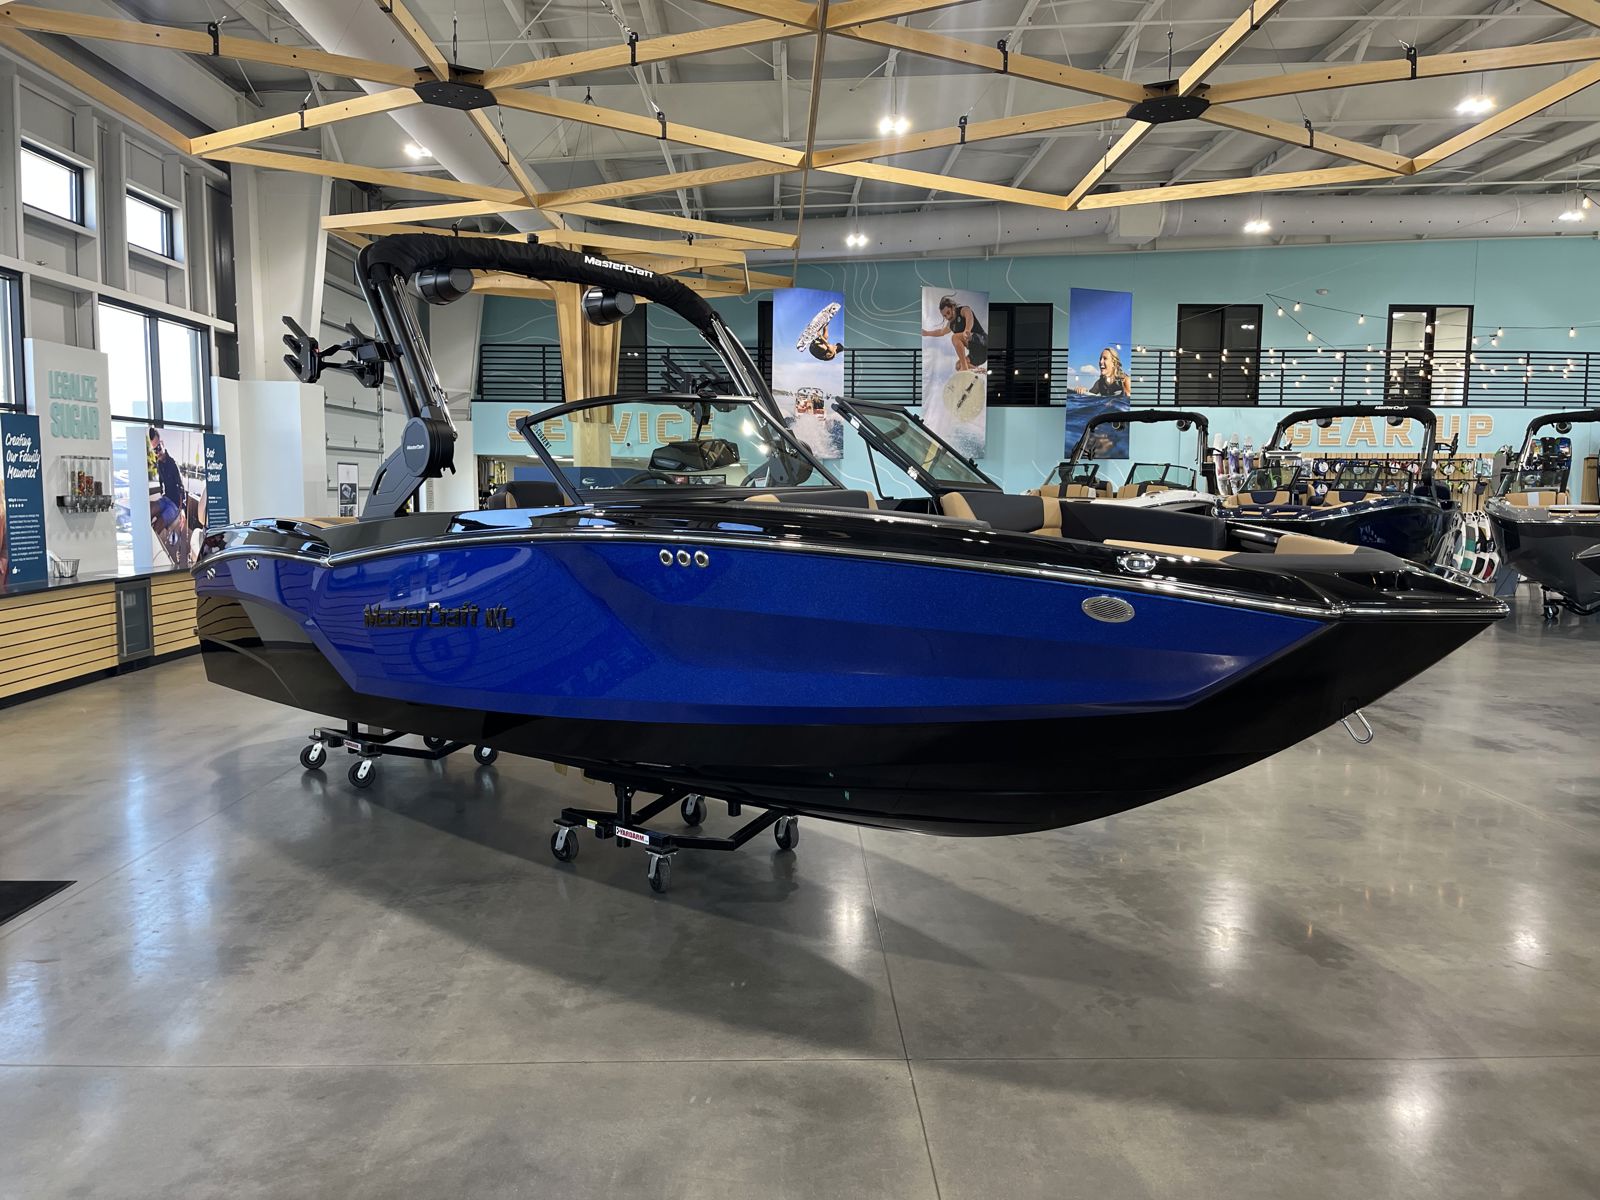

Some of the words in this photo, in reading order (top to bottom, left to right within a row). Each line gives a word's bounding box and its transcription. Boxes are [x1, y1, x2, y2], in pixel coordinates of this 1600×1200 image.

[584, 255, 654, 278] MasterCraft
[48, 370, 97, 402] LEGALIZE
[50, 402, 100, 440] SUGAR
[507, 409, 714, 445] SEVICE
[1286, 415, 1414, 447] GEAR
[1434, 414, 1495, 448] UP
[5, 433, 32, 453] Creating
[535, 428, 552, 449] CURRENT
[6, 450, 18, 463] Our
[19, 449, 40, 470] Family
[7, 465, 37, 480] Memories
[364, 602, 479, 628] MasterCraft
[620, 828, 645, 842] YARDARM
